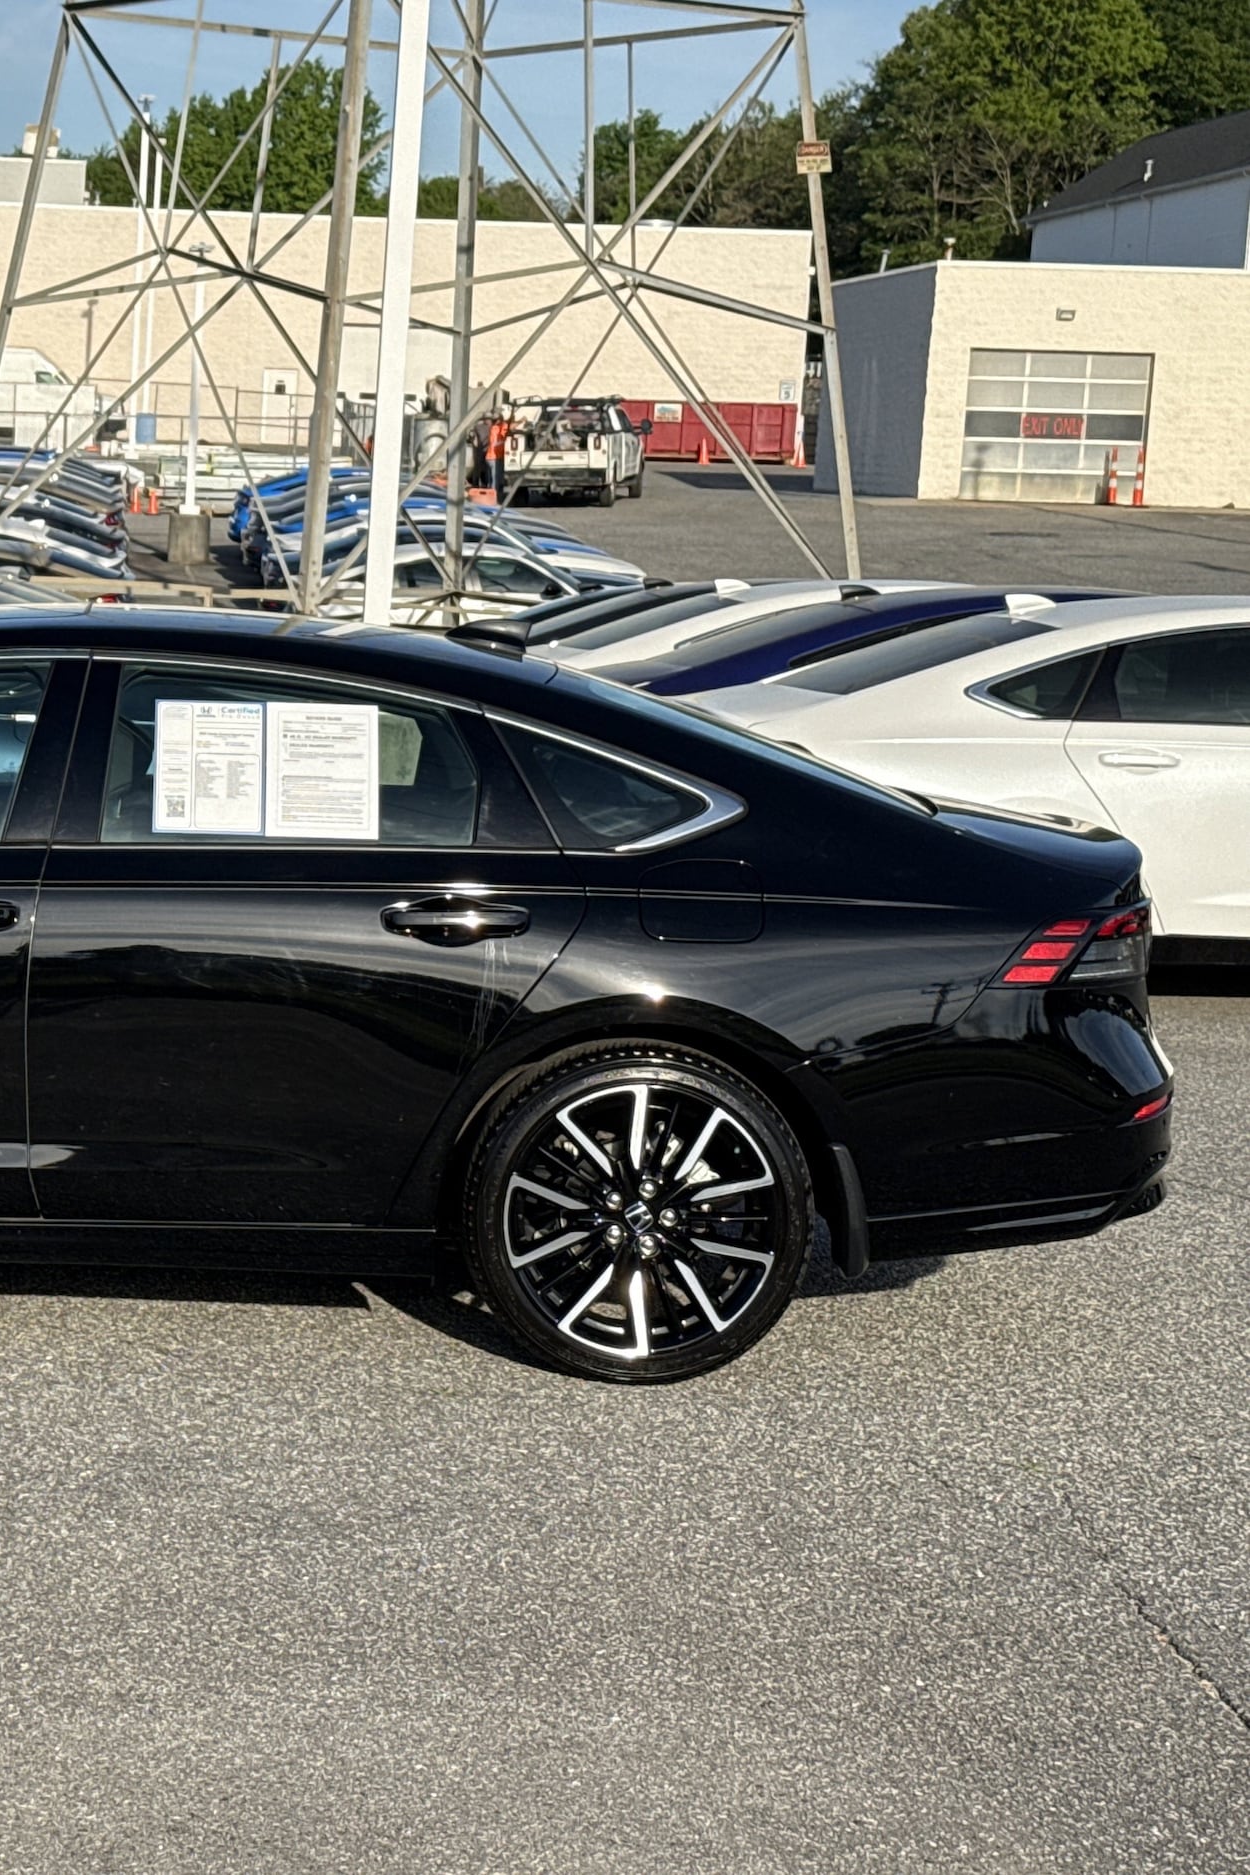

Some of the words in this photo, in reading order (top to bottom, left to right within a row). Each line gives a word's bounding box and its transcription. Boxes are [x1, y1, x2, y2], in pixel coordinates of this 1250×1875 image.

[1022, 416, 1049, 435] EXIT
[1053, 416, 1084, 436] ONLY
[221, 706, 260, 714] Certified
